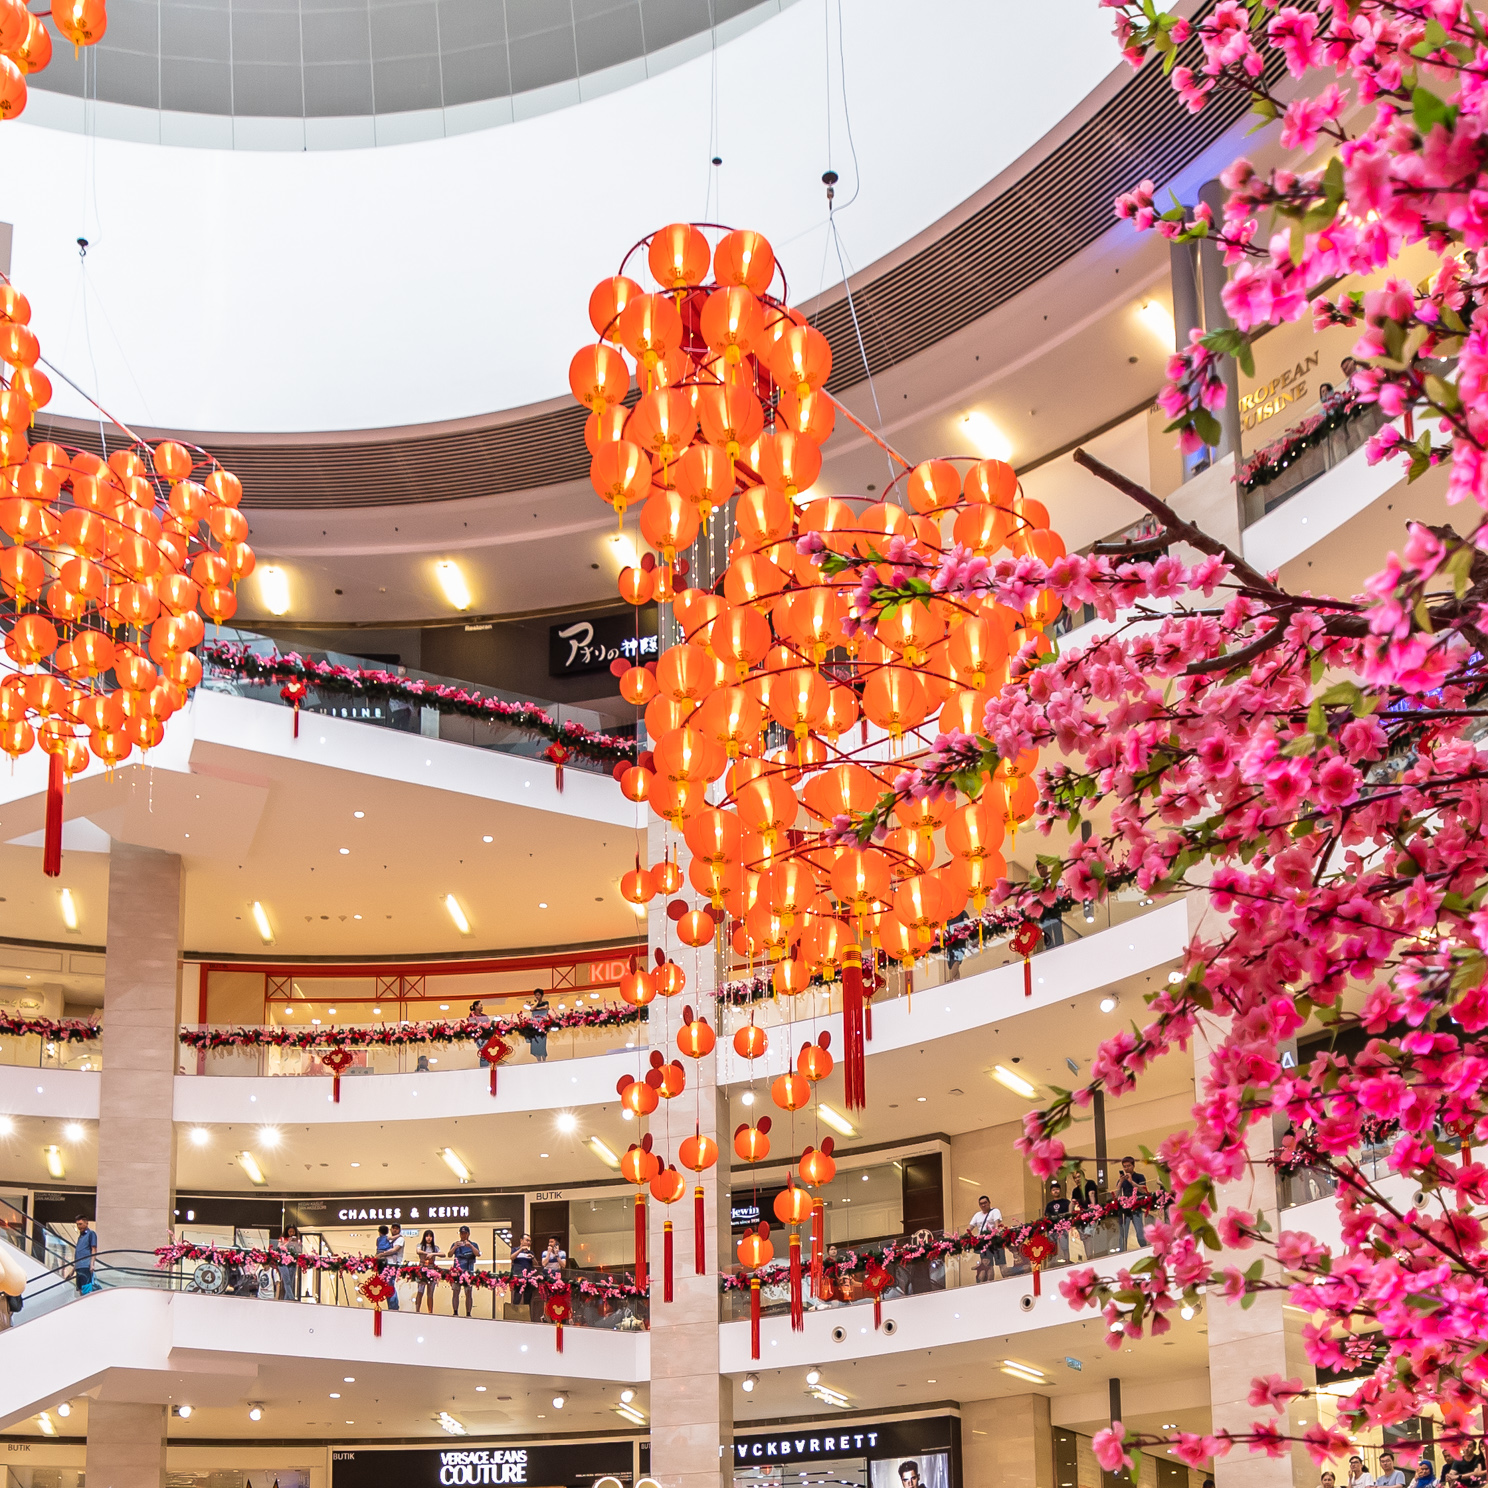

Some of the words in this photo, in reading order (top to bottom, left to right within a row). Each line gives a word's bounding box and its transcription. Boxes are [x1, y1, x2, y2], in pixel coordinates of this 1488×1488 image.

[1240, 380, 1308, 434] UISINE
[536, 1192, 563, 1201] BUTIK
[338, 1208, 401, 1220] CHARLES
[410, 1208, 420, 1218] &
[428, 1206, 469, 1217] KEITH
[7, 1443, 31, 1452] BUTIK
[332, 1452, 355, 1461] BUTIK
[440, 1451, 490, 1465] VERSACE
[491, 1450, 528, 1464] JEANS
[440, 1463, 528, 1486] COUTURE
